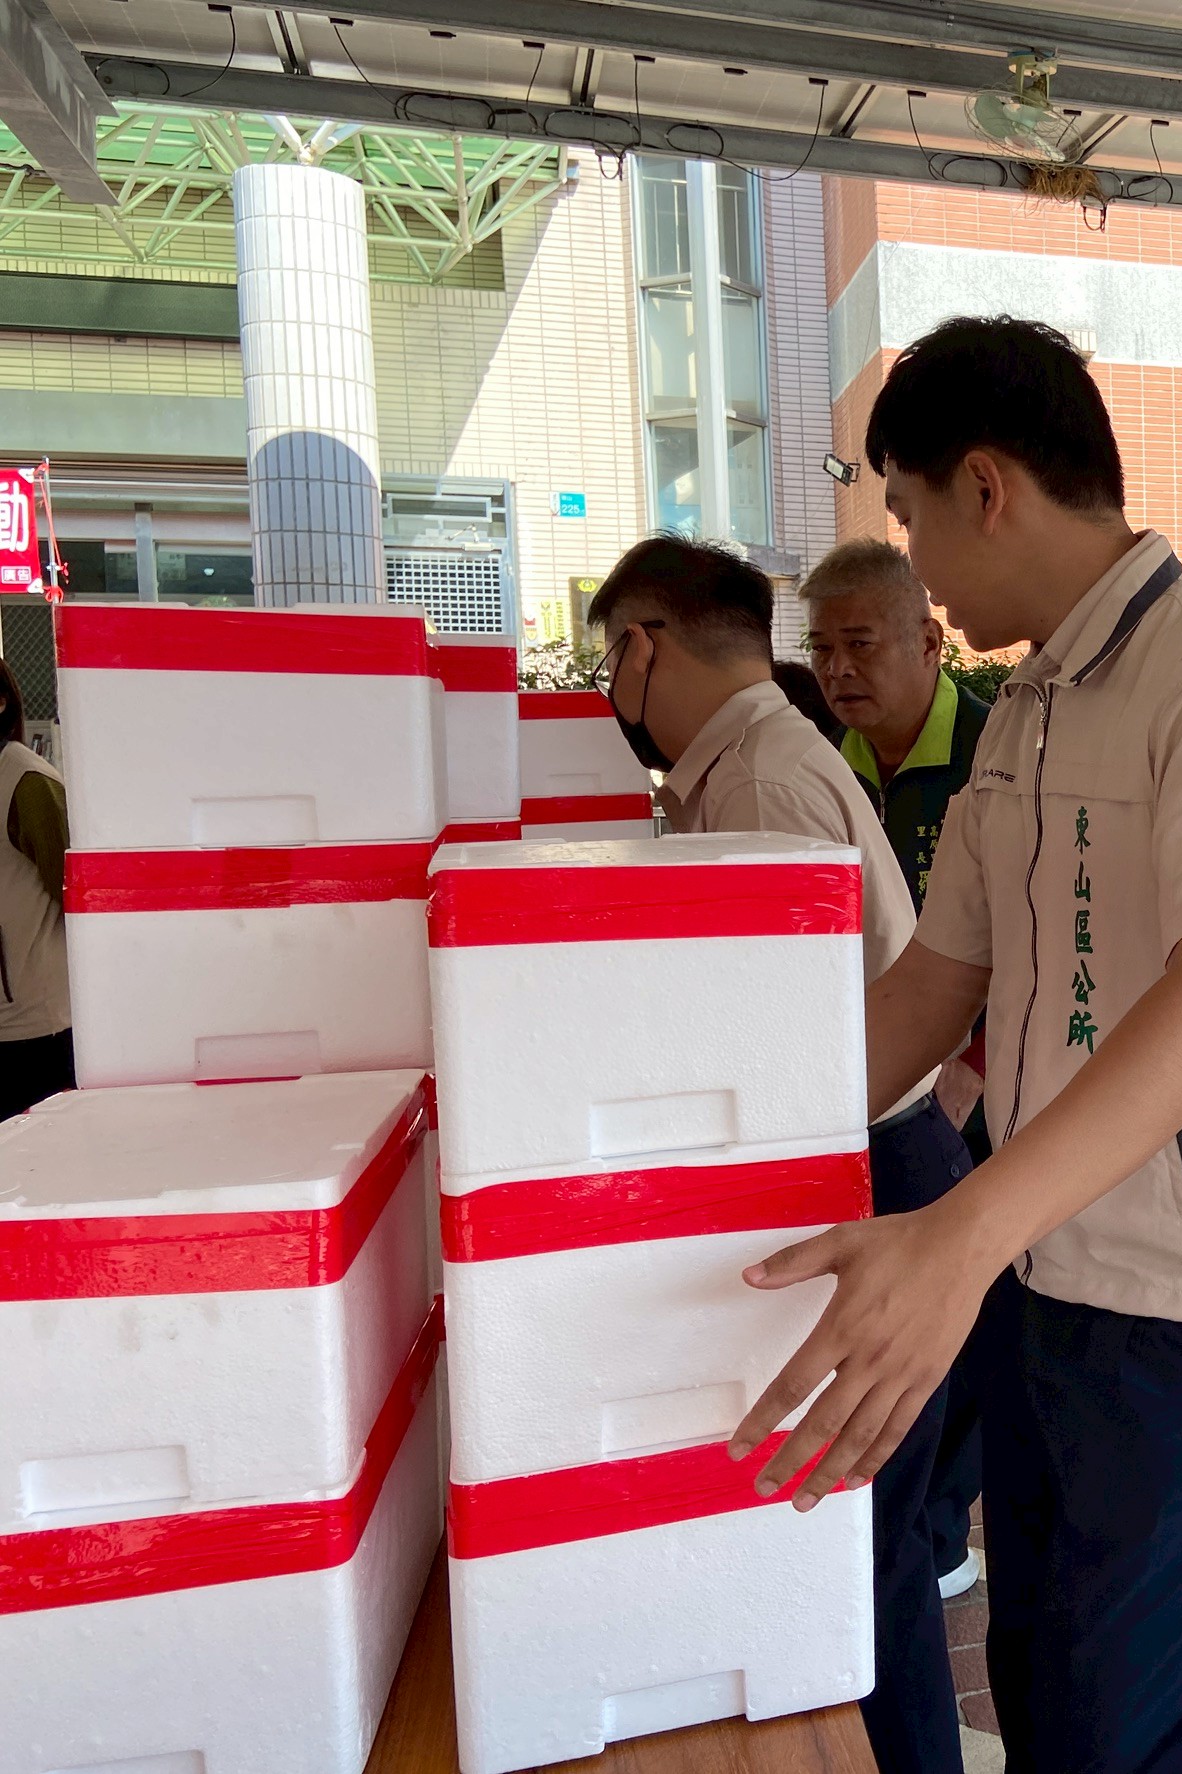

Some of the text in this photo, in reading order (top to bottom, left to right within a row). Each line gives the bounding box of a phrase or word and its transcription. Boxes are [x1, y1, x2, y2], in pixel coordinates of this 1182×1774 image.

[1067, 806, 1099, 1055] 東山區公所
